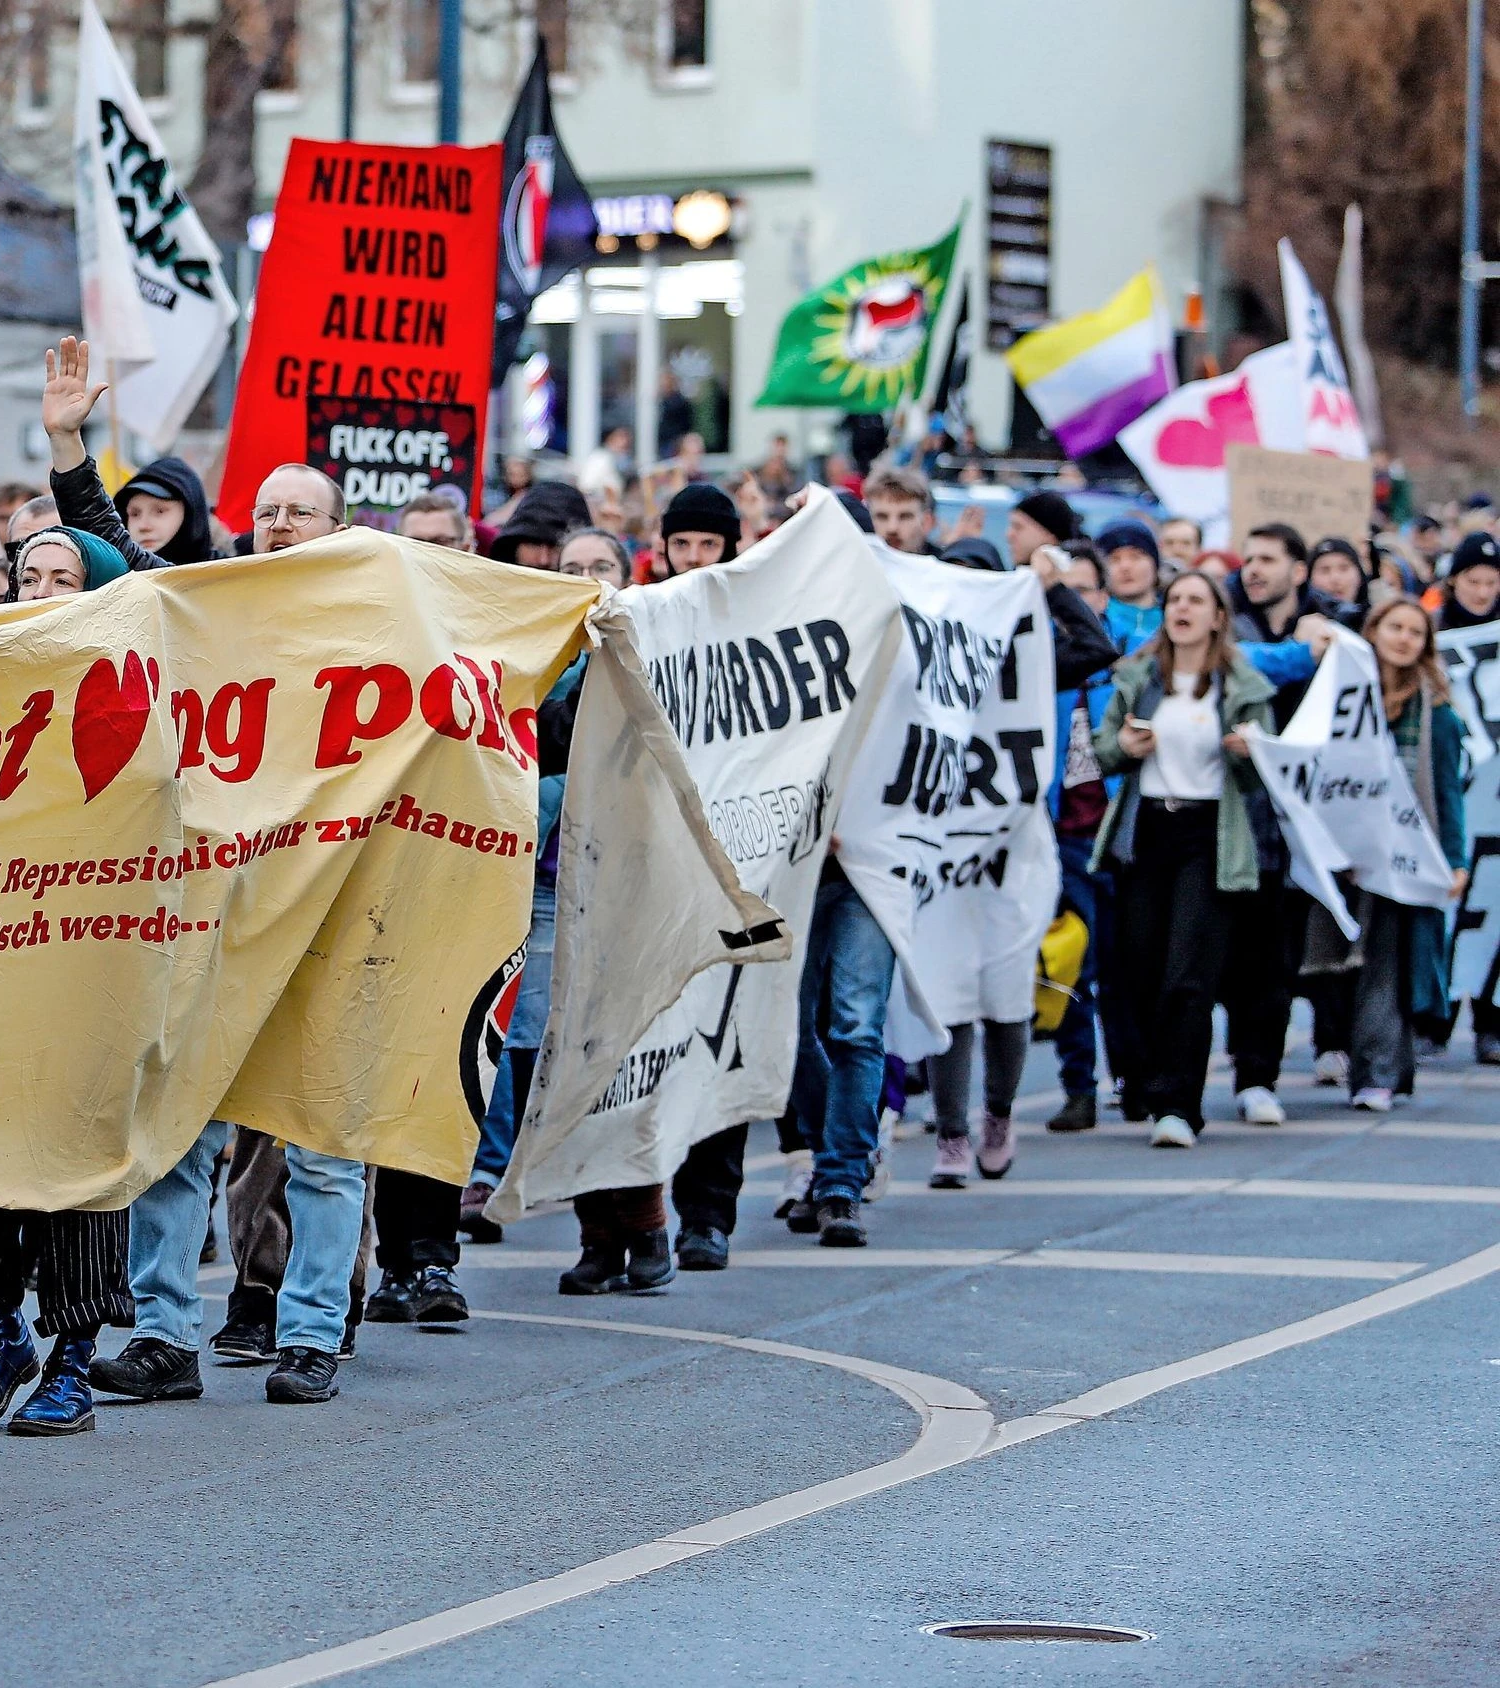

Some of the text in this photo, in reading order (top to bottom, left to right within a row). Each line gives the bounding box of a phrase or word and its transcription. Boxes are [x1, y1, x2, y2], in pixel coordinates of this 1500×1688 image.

[310, 156, 473, 216] NIEMAND
[343, 226, 448, 280] WIRD
[321, 294, 449, 348] ALLEIN
[329, 424, 395, 464] FUCK
